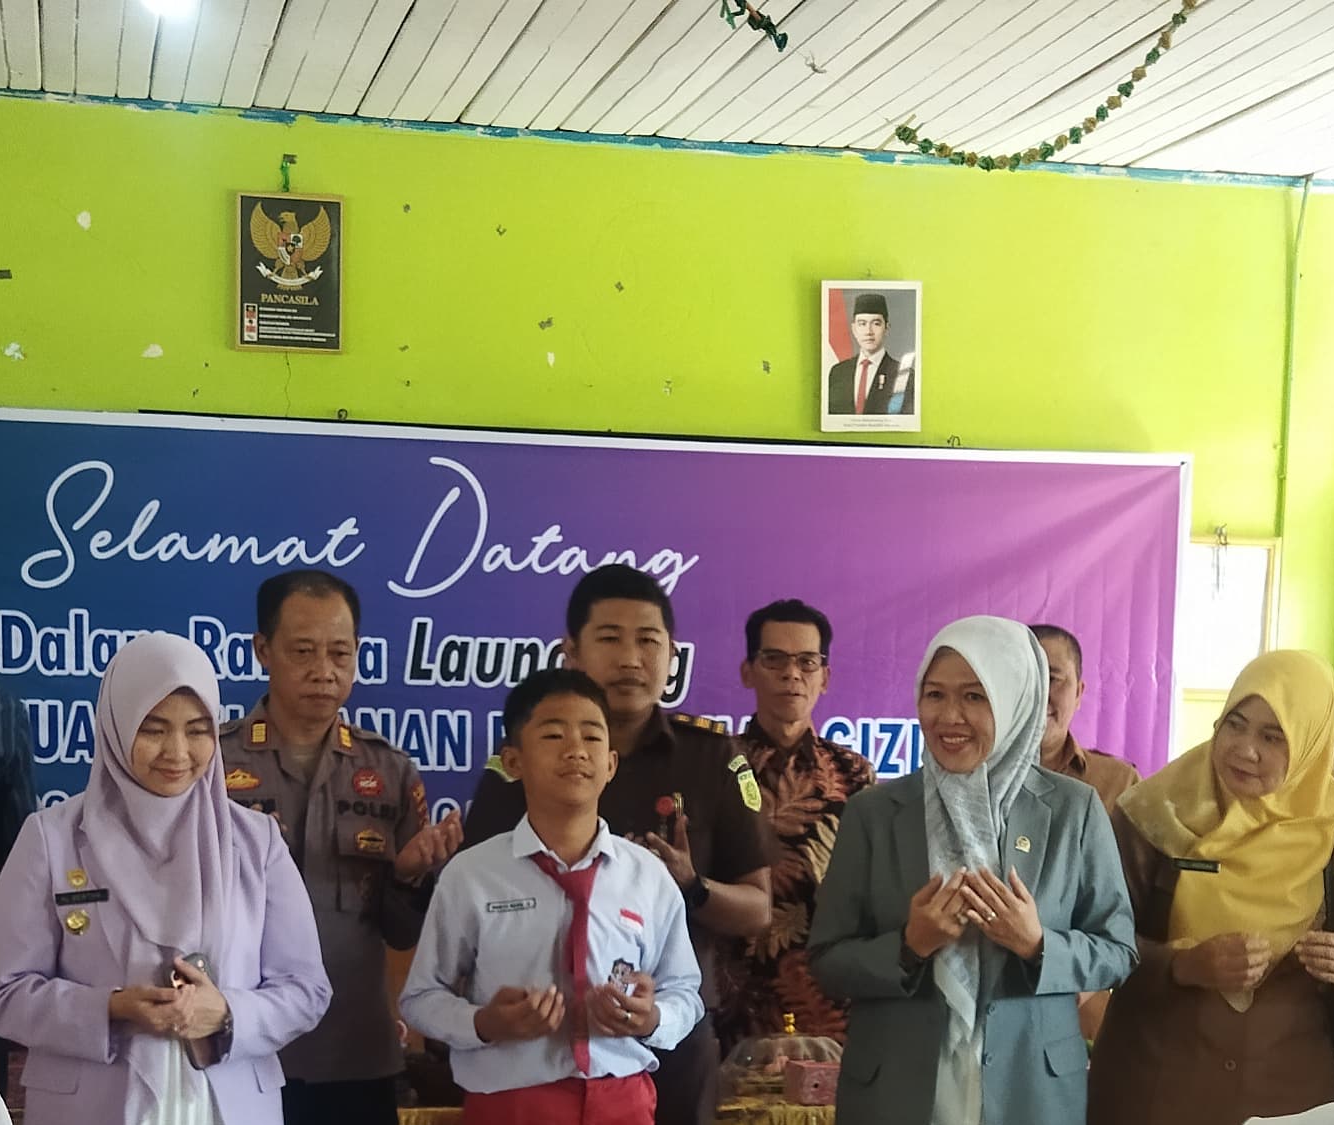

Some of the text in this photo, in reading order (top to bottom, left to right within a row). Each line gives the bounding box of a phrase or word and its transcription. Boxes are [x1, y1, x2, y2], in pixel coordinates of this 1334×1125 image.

[261, 293, 319, 306] PANCASILA
[21, 456, 699, 598] Selamat Datang
[189, 615, 388, 685] Raa
[404, 617, 696, 709] Laung
[338, 799, 397, 819] POLRI
